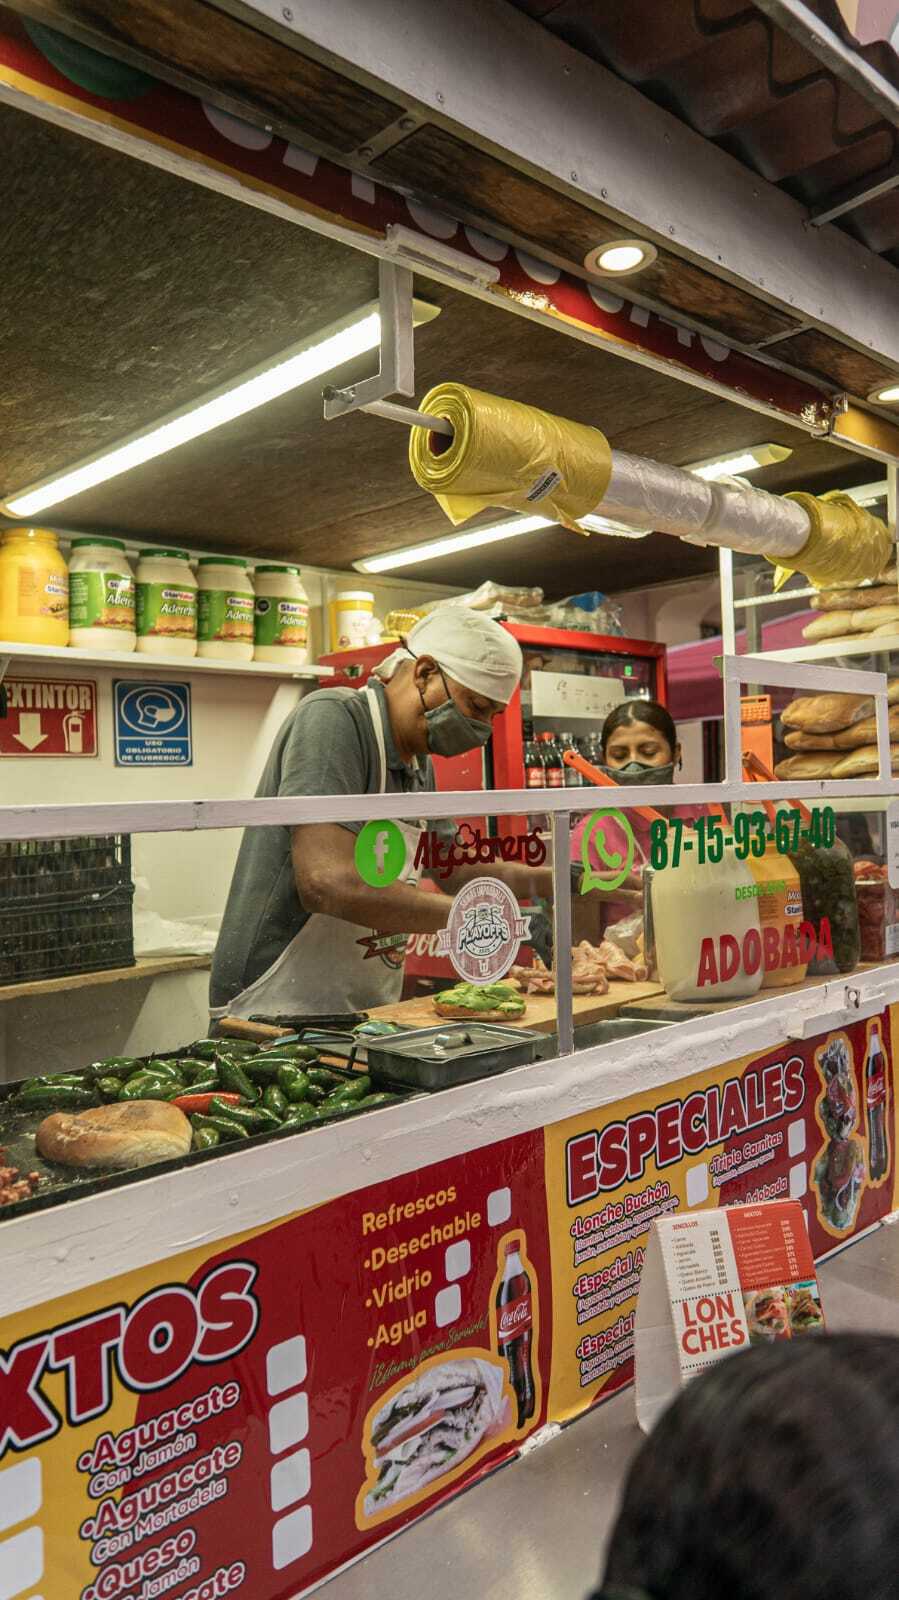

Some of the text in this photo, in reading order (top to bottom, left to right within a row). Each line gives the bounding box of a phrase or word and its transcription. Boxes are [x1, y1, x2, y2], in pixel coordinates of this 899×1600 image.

[3, 681, 91, 710] EXTINTOR
[650, 806, 837, 871] 87-15-93-67-40
[459, 924, 510, 951] PLAYOFFS
[696, 915, 835, 987] ADOBADA
[567, 1057, 806, 1205] ESPECIALES
[713, 1131, 784, 1172] Triple Carnitas
[362, 1186, 457, 1236] Refrescos
[575, 1181, 670, 1236] Lonche Buchón
[745, 1176, 788, 1204] Adobada
[371, 1211, 481, 1271] Desechable
[372, 1269, 432, 1308] Vidrio
[578, 1252, 634, 1295] Especial
[375, 1309, 427, 1349] Agua
[581, 1311, 635, 1357] Especial
[682, 1293, 736, 1328] LON
[681, 1319, 746, 1356] CHES
[91, 1382, 240, 1472] Aguacate
[89, 1432, 197, 1498] Con Jamón
[93, 1442, 242, 1540] Aguacate
[92, 1478, 228, 1564] Con Mortadela
[94, 1529, 197, 1600] Queso
